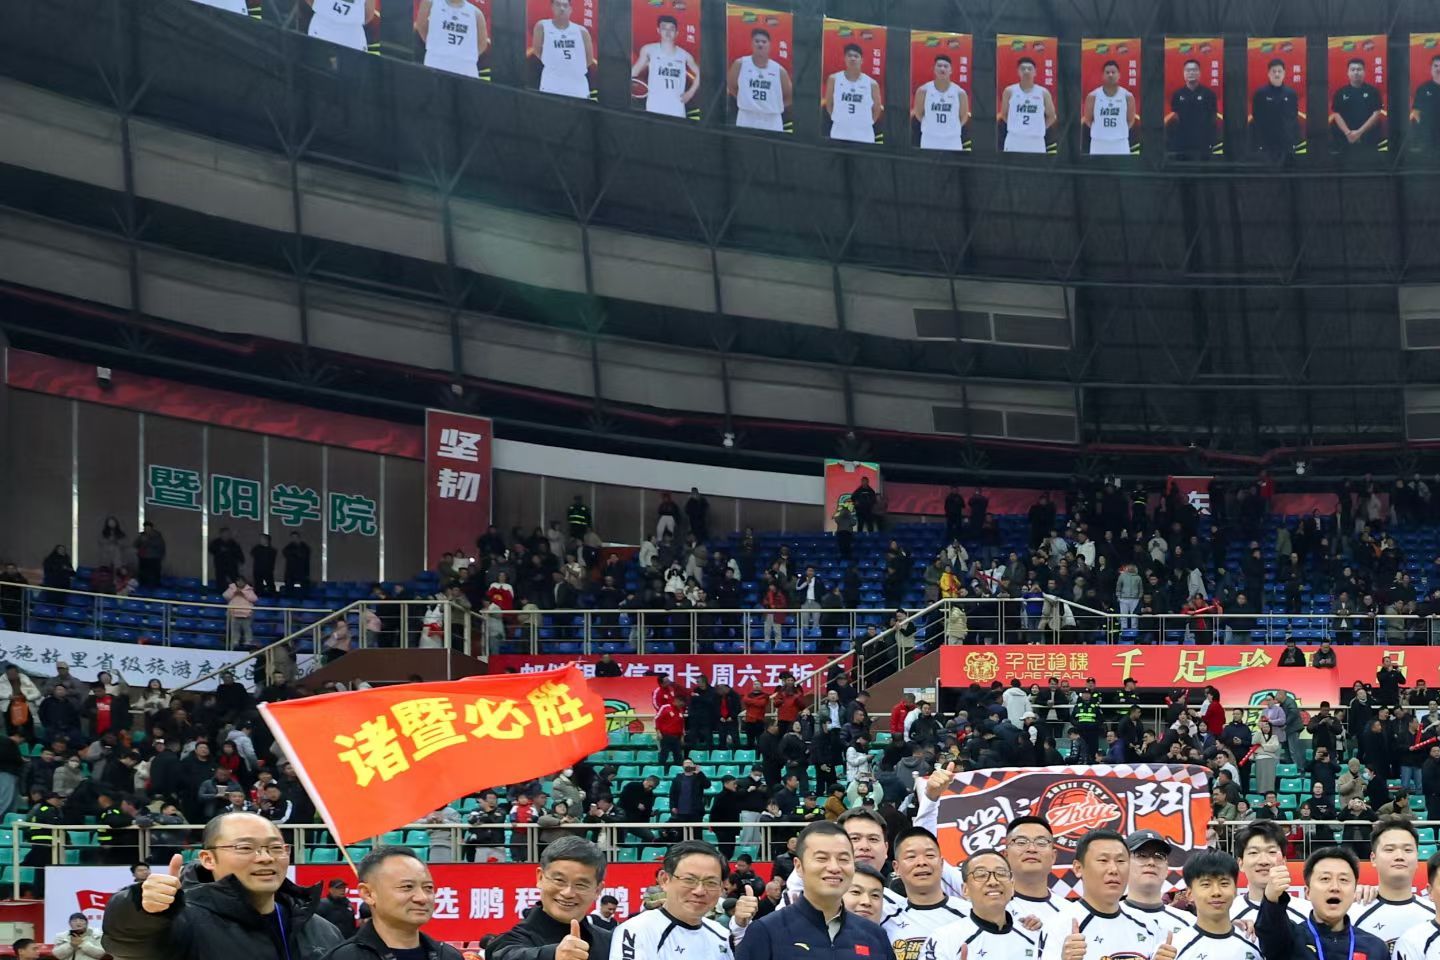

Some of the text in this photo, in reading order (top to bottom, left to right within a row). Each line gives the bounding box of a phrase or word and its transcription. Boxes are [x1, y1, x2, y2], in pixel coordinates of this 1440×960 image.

[332, 2, 351, 16] 47
[448, 33, 464, 46] 37
[563, 50, 571, 60] 5
[665, 78, 675, 89] 11
[752, 90, 767, 101] 28
[848, 103, 855, 114] 3
[936, 113, 947, 124] 10
[1022, 115, 1030, 125] 2
[437, 428, 482, 503] 坚韧
[145, 463, 378, 537] 暨阳学院
[1112, 648, 1317, 684] 千足珍
[1005, 671, 1089, 680] PURE PEARL
[333, 679, 594, 787] 诸暨必胜
